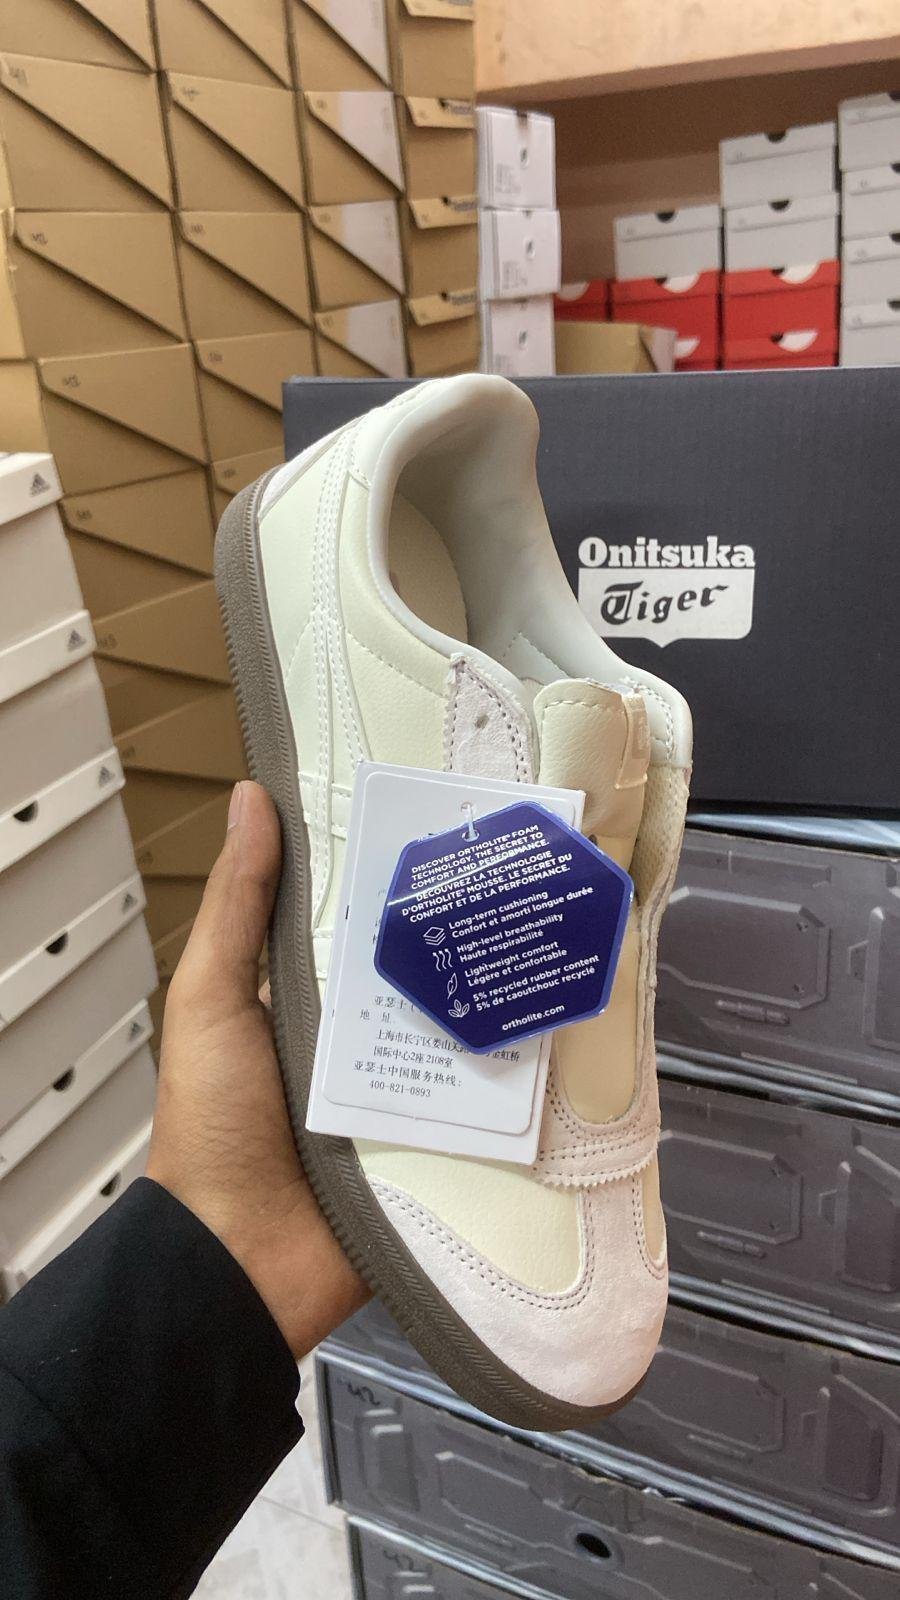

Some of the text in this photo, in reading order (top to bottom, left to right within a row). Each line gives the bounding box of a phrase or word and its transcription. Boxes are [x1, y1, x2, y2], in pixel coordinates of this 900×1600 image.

[578, 535, 756, 568] Onitsuka
[600, 580, 730, 625] Tiger
[411, 853, 456, 873] DISCOVER
[511, 824, 539, 838] FOAM
[411, 831, 543, 881] TECHNOLOGY. THE SECRET TO
[411, 838, 550, 890] COMFORT AND PERFORMANCE.
[473, 872, 486, 882] LA
[487, 850, 553, 877] TECHNOLOGIE
[409, 863, 571, 923] CONFORT ET DE LA PERFORMANCE.
[466, 875, 508, 894] MOUSSE.
[508, 870, 520, 880] LE
[521, 859, 556, 875] SECRET
[557, 852, 573, 864] DU
[448, 891, 549, 929] Long-term cushioning
[451, 886, 594, 938] Confort et amorti longue durée
[456, 913, 564, 953] High-level breathability
[459, 929, 544, 963] Haute respirabilité
[464, 941, 559, 978] Lightweight comfort
[467, 948, 568, 987] Légère et confortable
[472, 954, 600, 1002] 5% recycled rubber content
[476, 965, 596, 1011] 5% de caoutchouc recyclé
[501, 1004, 565, 1031] ortholite.com
[369, 1079, 431, 1098] 400-821-0893
